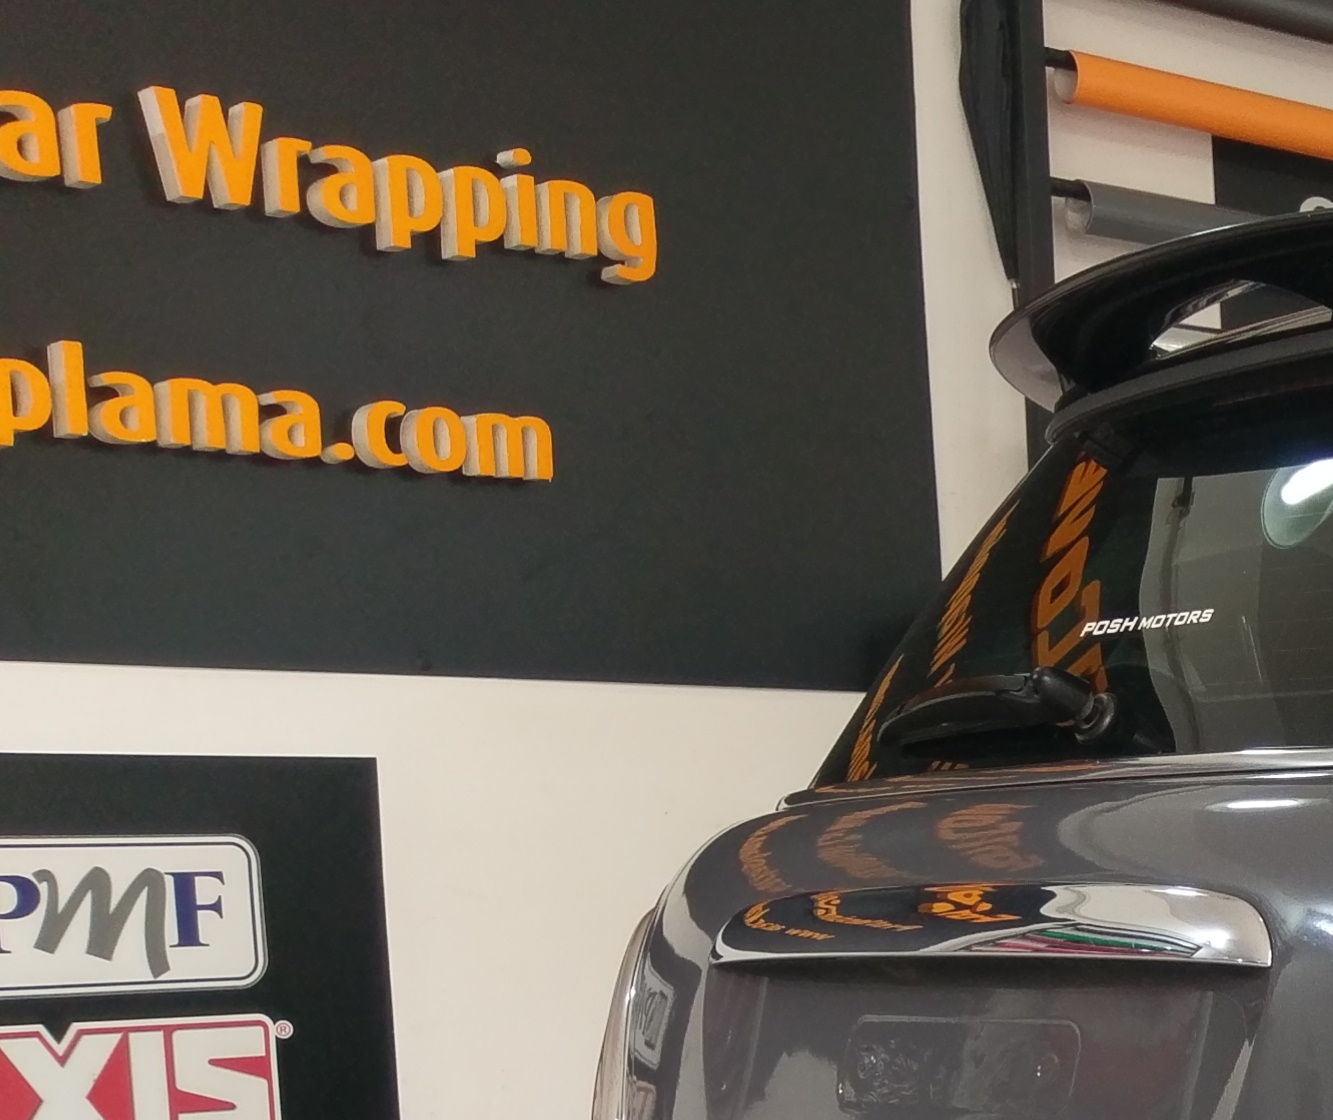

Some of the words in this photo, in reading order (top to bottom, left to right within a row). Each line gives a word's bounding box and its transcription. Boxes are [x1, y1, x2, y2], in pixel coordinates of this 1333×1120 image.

[137, 86, 657, 285] Wrapping
[1079, 616, 1139, 638] POSH
[1138, 608, 1215, 631] MOTORS
